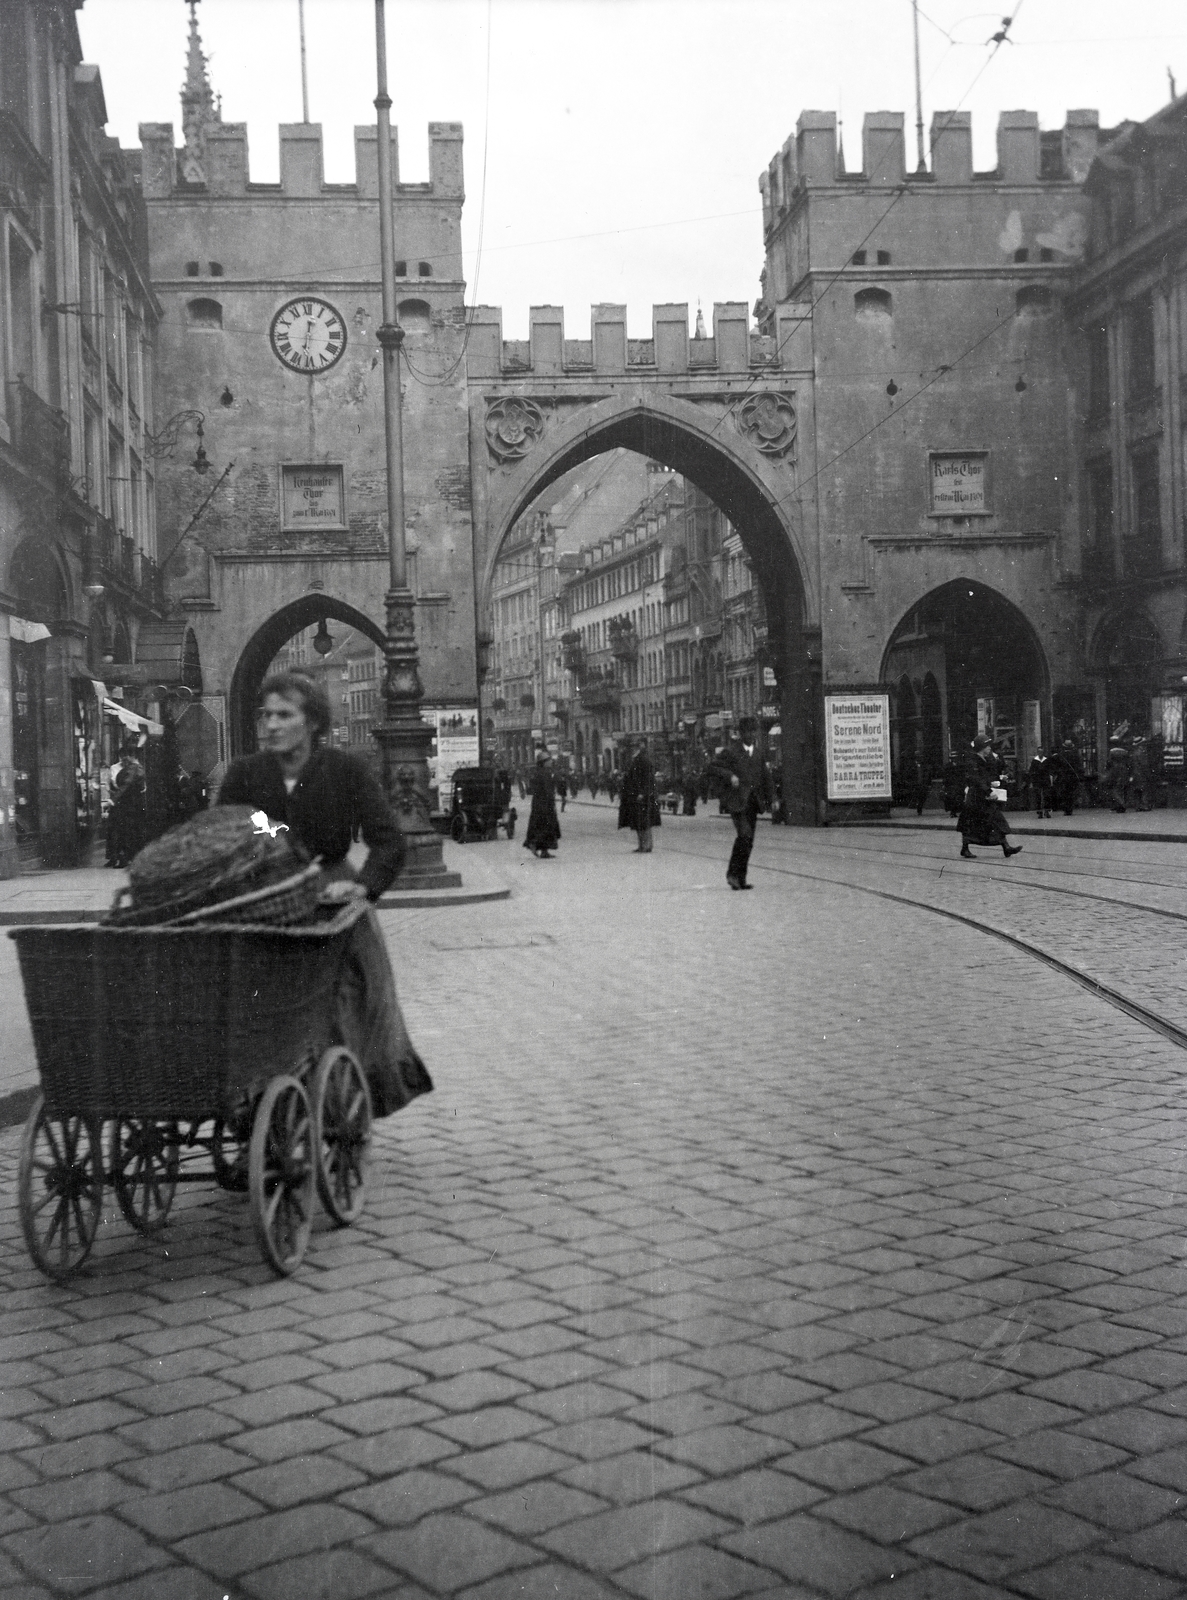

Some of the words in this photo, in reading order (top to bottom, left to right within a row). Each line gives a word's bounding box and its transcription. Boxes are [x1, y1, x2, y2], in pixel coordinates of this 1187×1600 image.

[279, 317, 292, 328] X
[325, 317, 337, 328] II
[329, 331, 341, 340] III
[934, 461, 959, 477] Karls
[959, 460, 982, 477] Thor
[303, 487, 324, 500] Thor
[860, 702, 881, 714] Theater
[863, 723, 882, 735] Nord
[859, 770, 884, 781] TRUPPE
